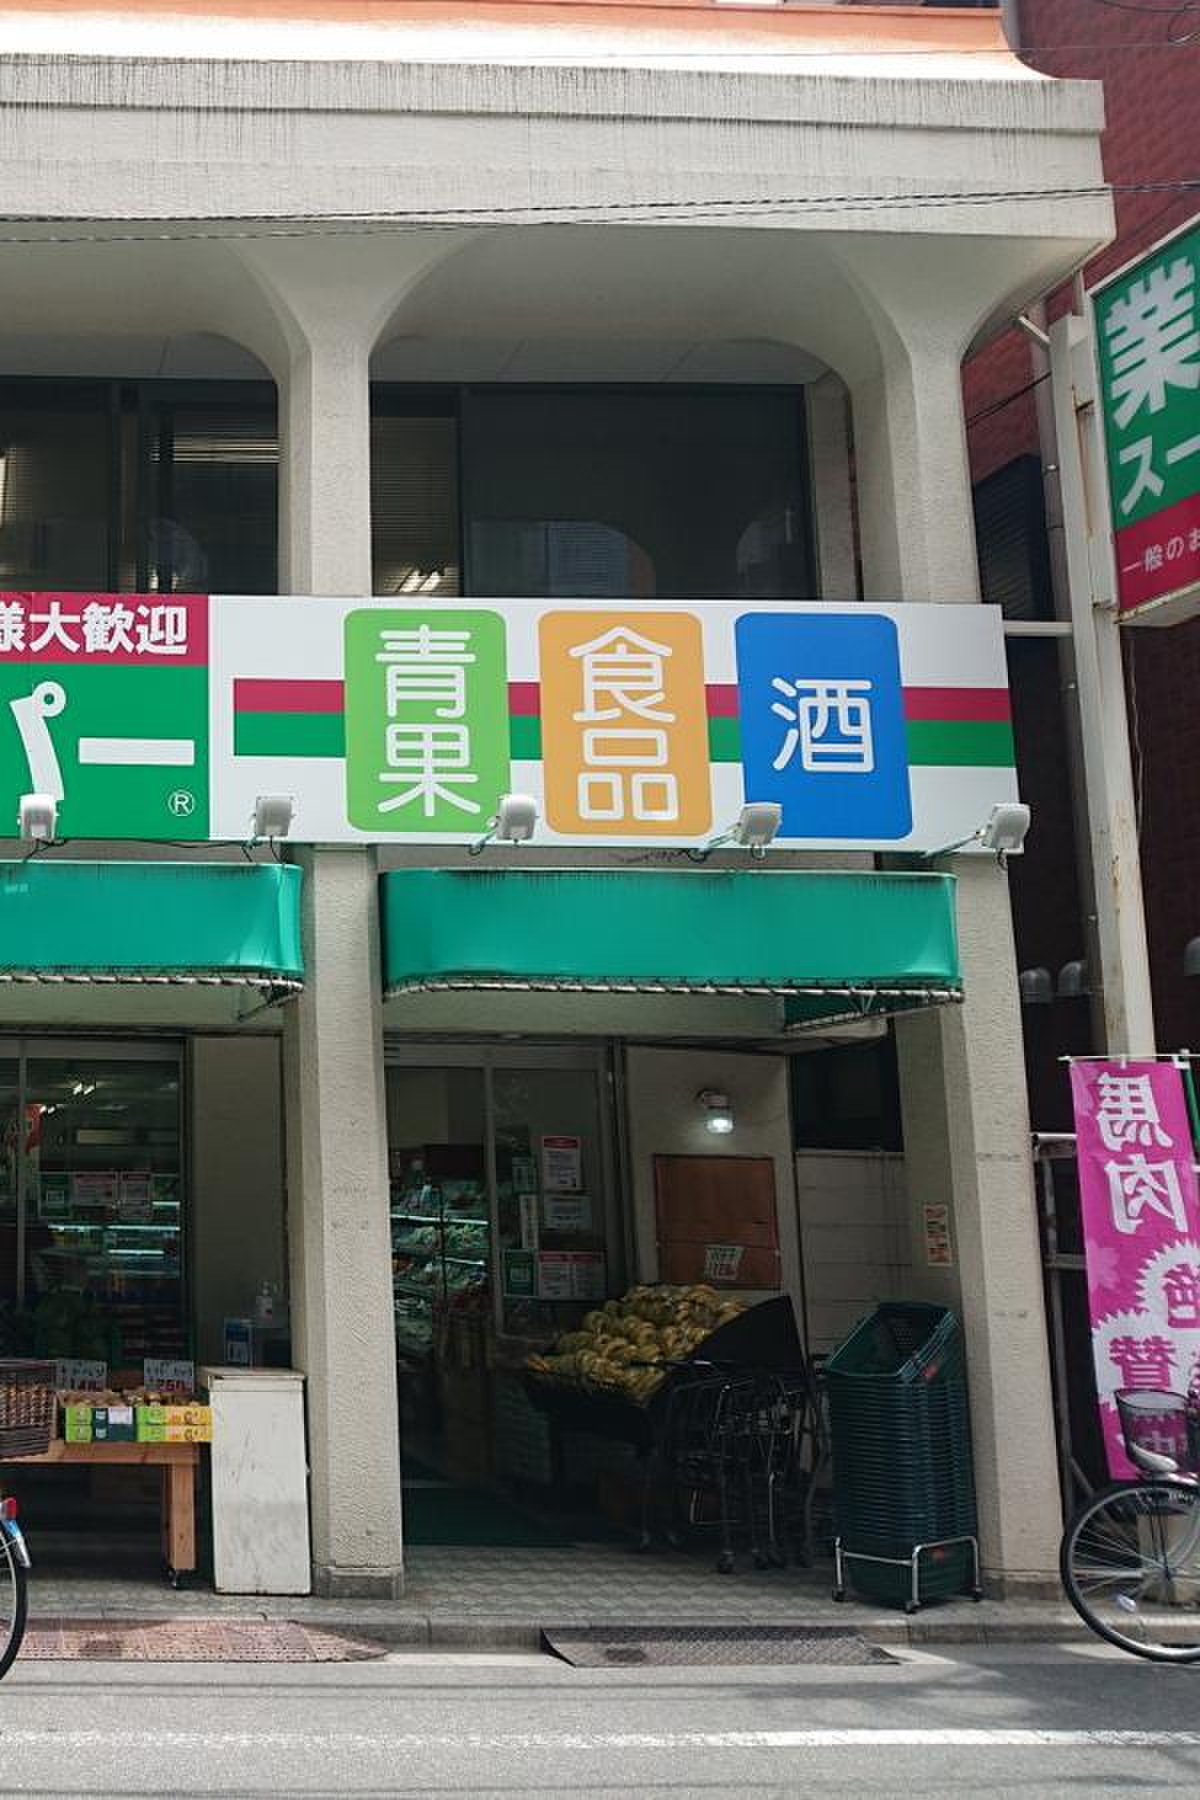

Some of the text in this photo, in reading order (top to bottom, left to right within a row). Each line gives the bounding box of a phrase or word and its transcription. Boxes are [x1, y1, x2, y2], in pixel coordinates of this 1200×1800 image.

[375, 624, 481, 816] 青果
[568, 625, 680, 822] 食品
[771, 676, 875, 774] 酒
